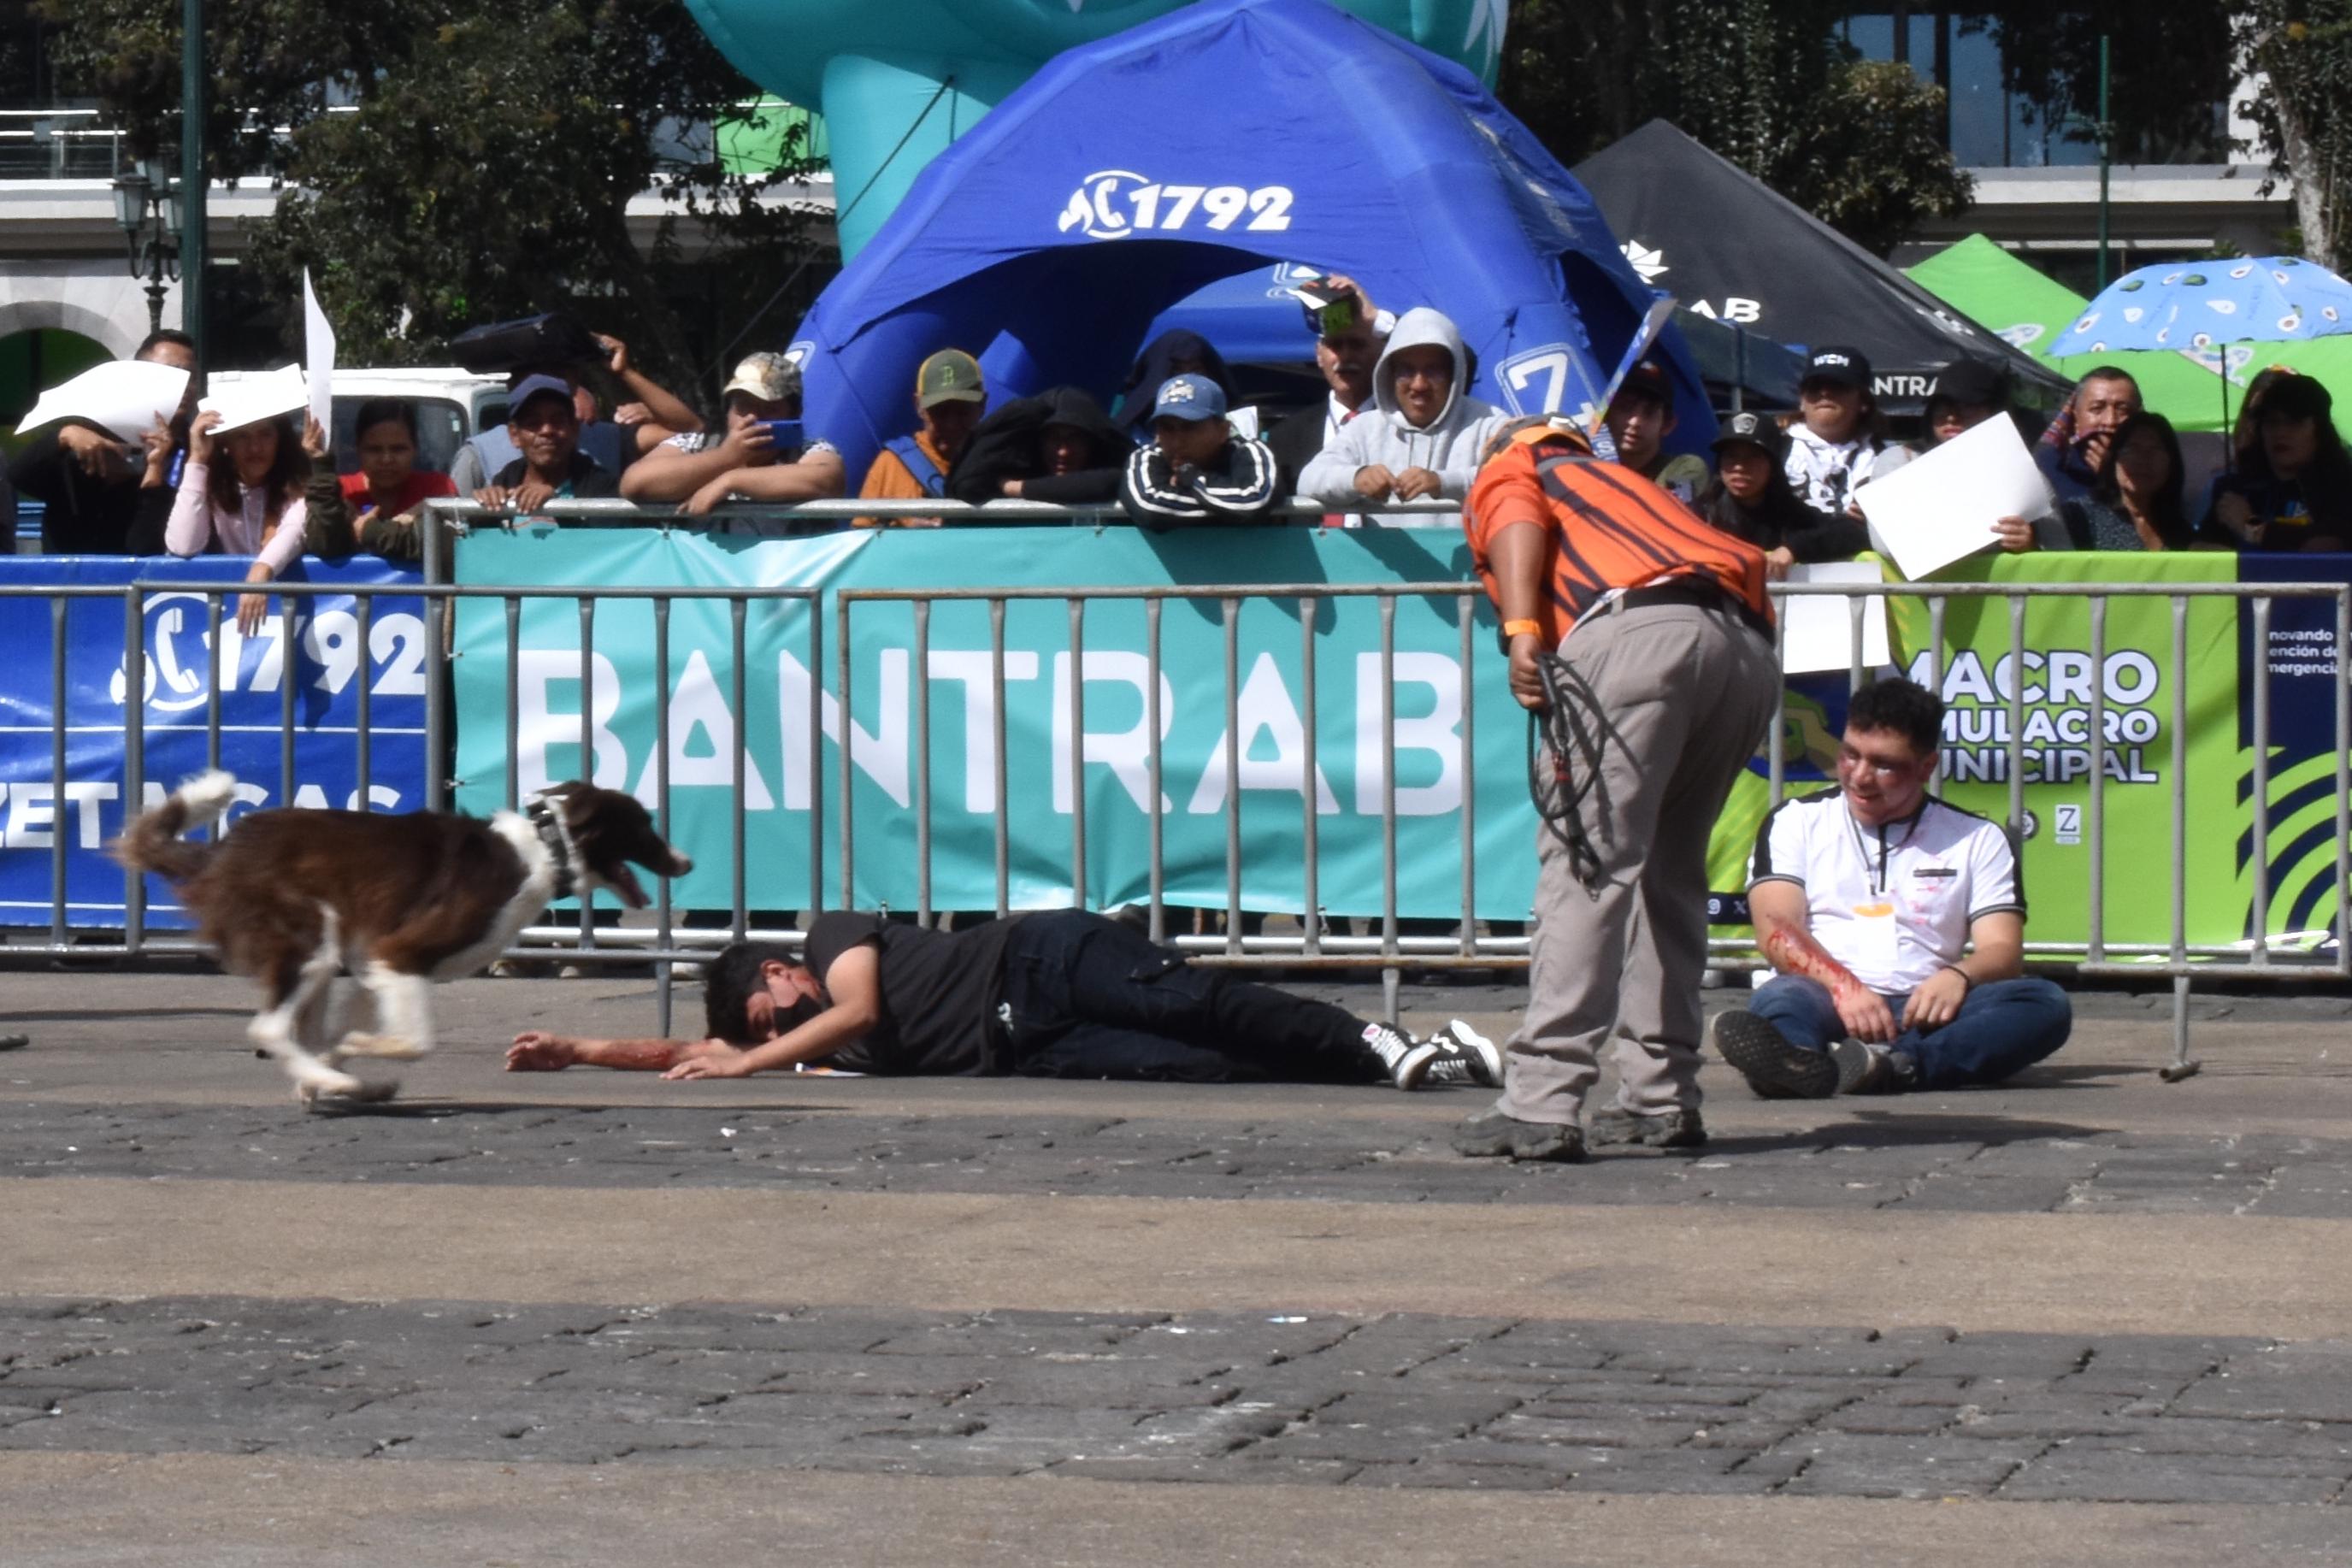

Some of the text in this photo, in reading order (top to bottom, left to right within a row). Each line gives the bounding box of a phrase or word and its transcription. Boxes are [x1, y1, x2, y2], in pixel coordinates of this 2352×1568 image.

[1127, 184, 1294, 232] 1792
[202, 610, 426, 695] 1792
[516, 647, 1464, 816] BANTRAB
[2058, 807, 2077, 832] Z
